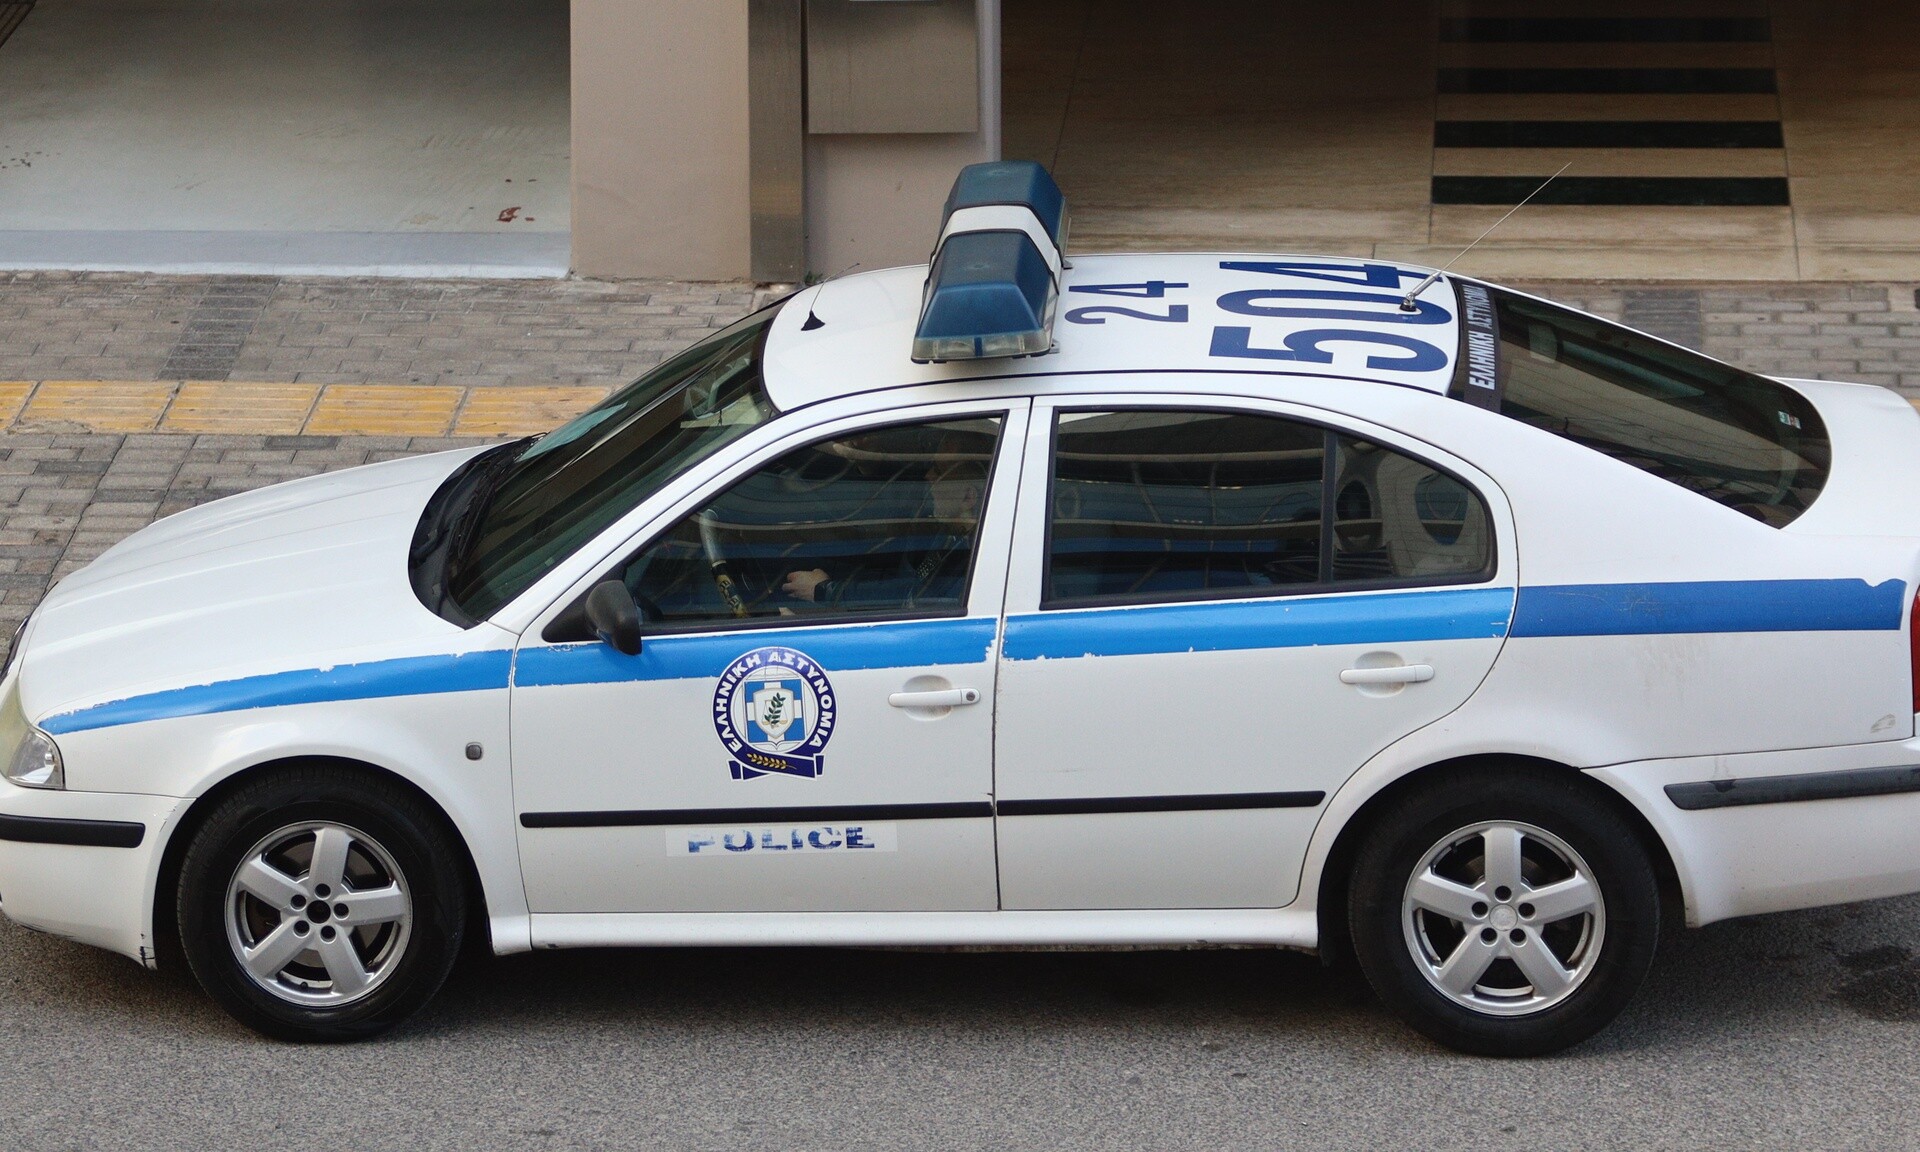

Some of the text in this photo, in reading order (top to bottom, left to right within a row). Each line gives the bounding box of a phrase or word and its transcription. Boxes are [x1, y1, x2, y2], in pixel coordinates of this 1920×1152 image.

[1065, 280, 1189, 325] 24
[1209, 261, 1453, 372] 504
[1468, 330, 1495, 390] ΕΛΛΗΝΙΚΗ
[716, 652, 833, 752] ΕΛΛΗΝΙΚΗ ΑΣΤΥΝΟΜΙΑ
[688, 827, 875, 853] POLICE
